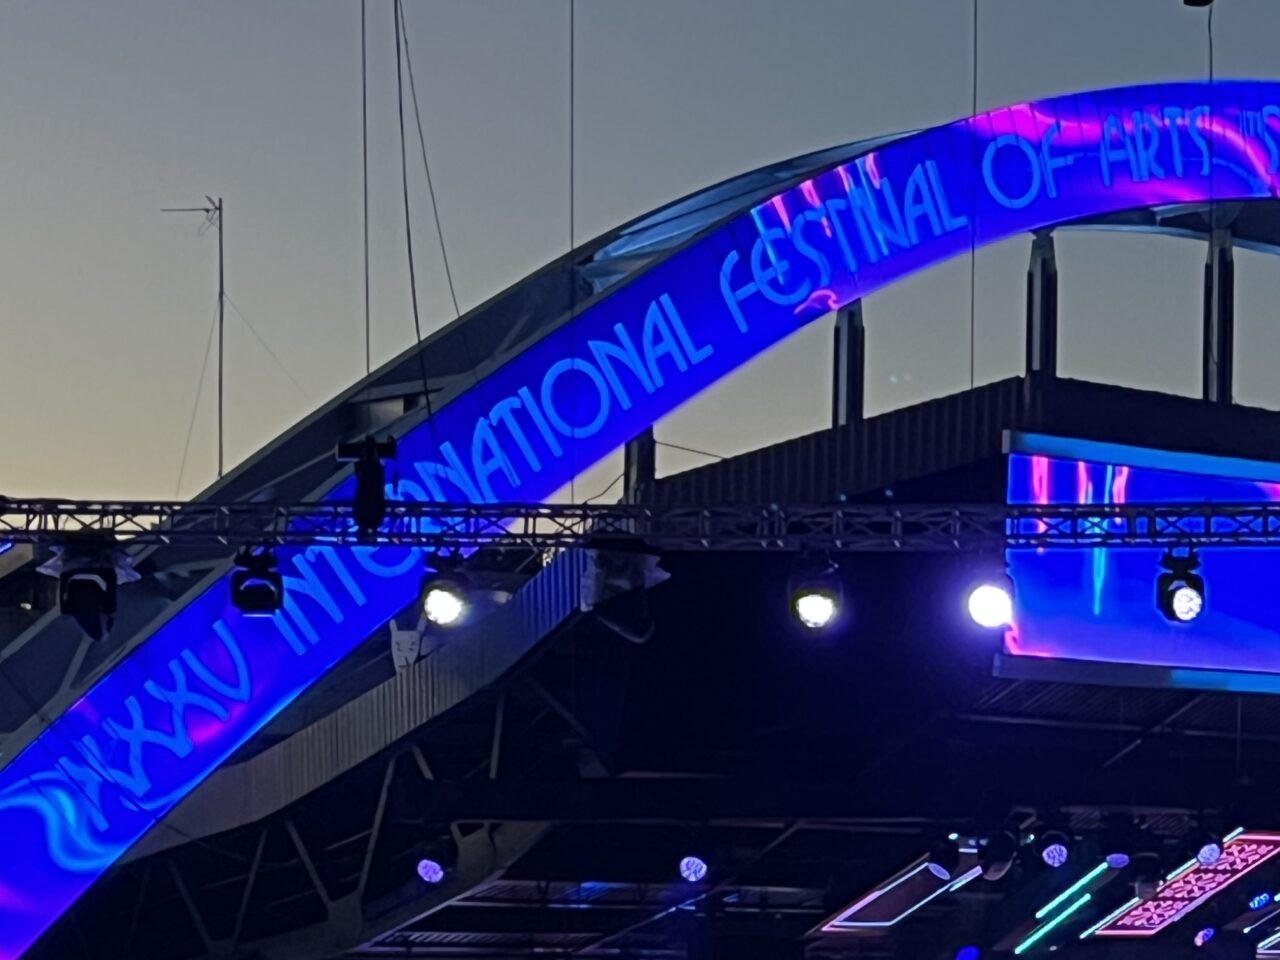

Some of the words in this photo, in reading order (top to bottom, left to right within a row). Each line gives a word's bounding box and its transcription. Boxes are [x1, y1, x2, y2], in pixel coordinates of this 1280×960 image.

[271, 293, 715, 656] INTENATIONAL
[719, 160, 968, 334] FESTIVAL
[982, 121, 1074, 209] OF
[1100, 106, 1210, 186] ARTS
